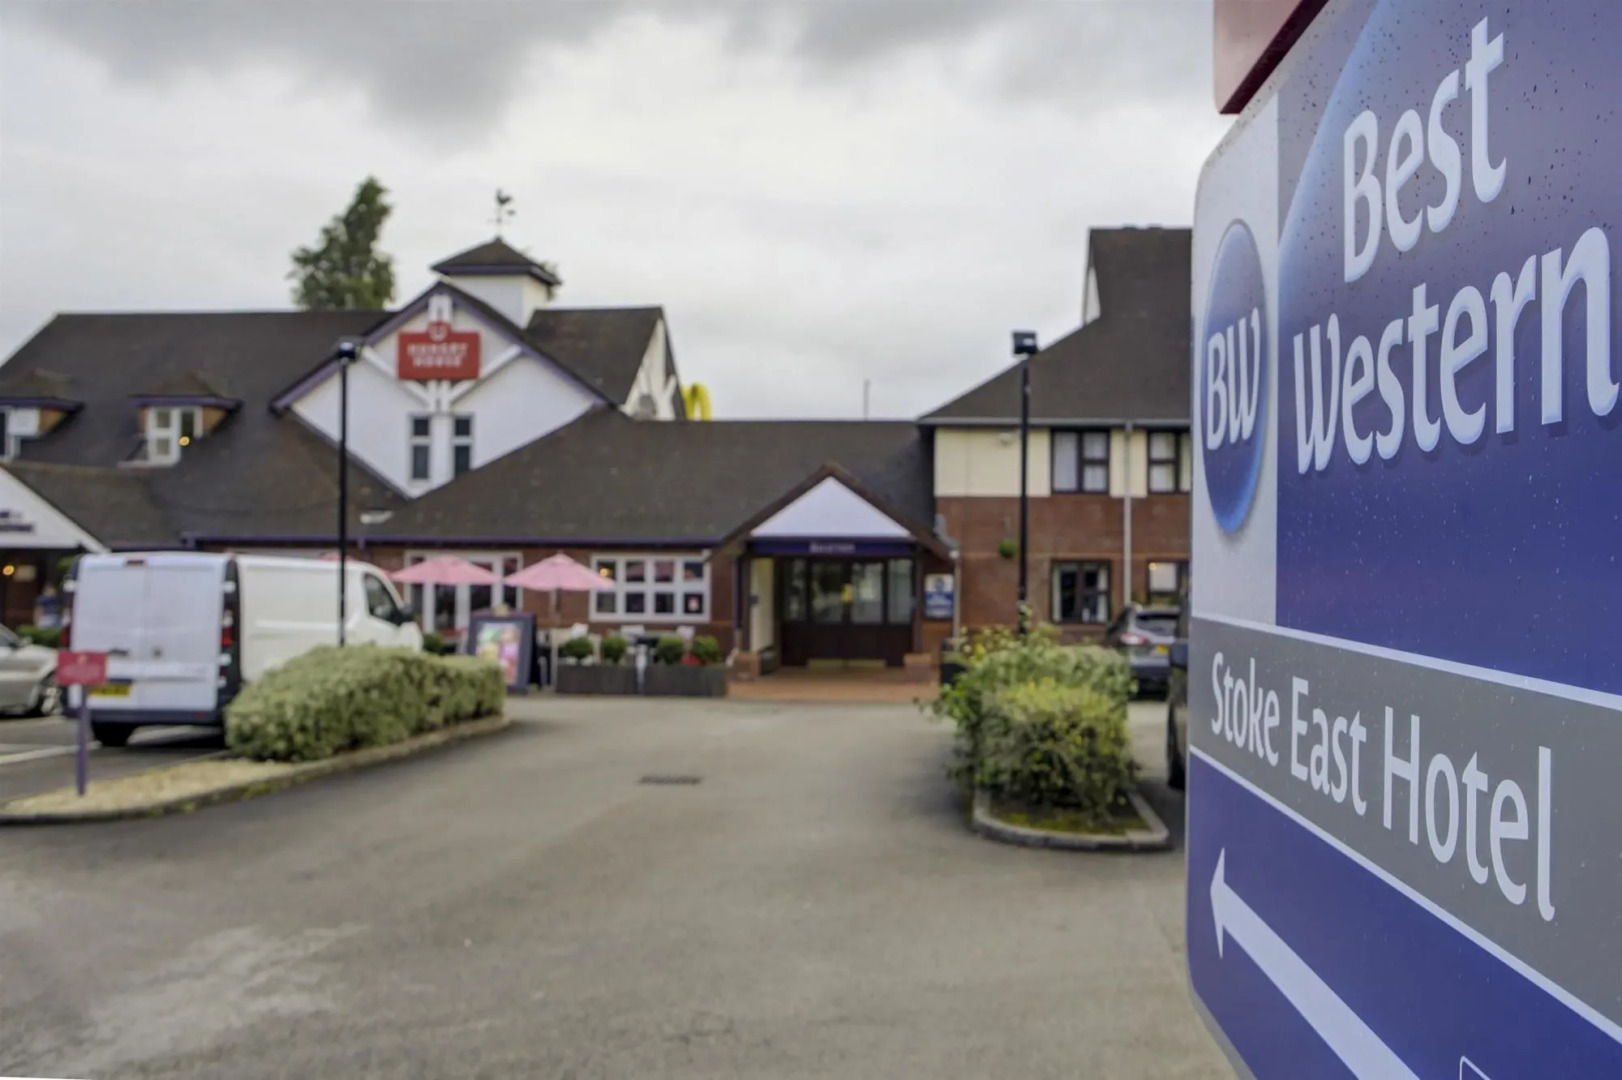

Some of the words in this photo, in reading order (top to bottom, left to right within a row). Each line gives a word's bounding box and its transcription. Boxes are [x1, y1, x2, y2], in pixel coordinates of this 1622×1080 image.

[1343, 17, 1507, 283] Best
[1206, 307, 1260, 450] BW
[1293, 226, 1620, 474] Western
[1211, 651, 1280, 767] Stoke
[1291, 676, 1367, 817] East
[1383, 705, 1556, 922] Hotel
